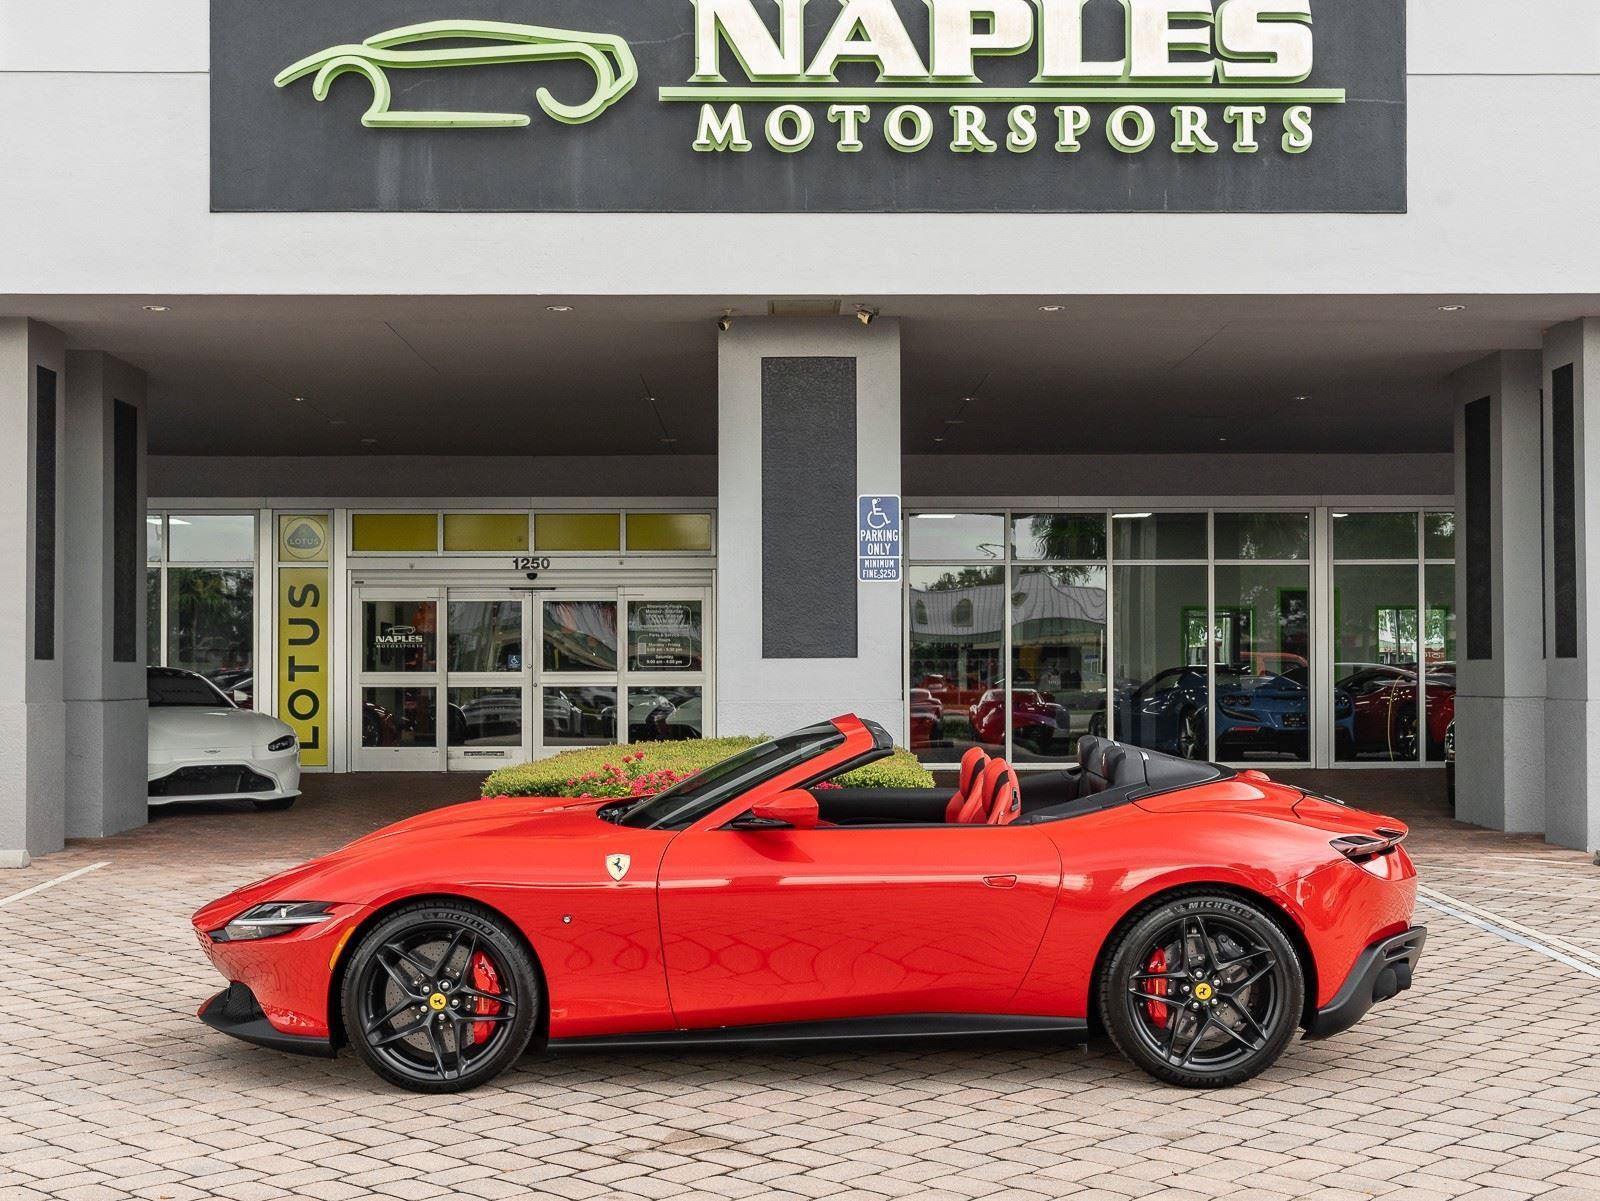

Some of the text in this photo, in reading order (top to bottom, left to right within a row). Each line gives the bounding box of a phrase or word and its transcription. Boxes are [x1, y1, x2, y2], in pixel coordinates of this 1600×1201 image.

[687, 0, 1315, 83] NAPLES
[692, 104, 1313, 153] MOTORSPORTS
[861, 530, 898, 541] PARKING
[867, 543, 891, 555] ONLY
[513, 557, 550, 569] 1250
[865, 559, 894, 568] MINIMUM
[863, 569, 896, 579] FINE $250
[376, 635, 423, 643] NAPLES
[288, 584, 320, 749] LOTUS
[1188, 901, 1253, 919] MICHELIN
[437, 912, 493, 935] MICHELIN
